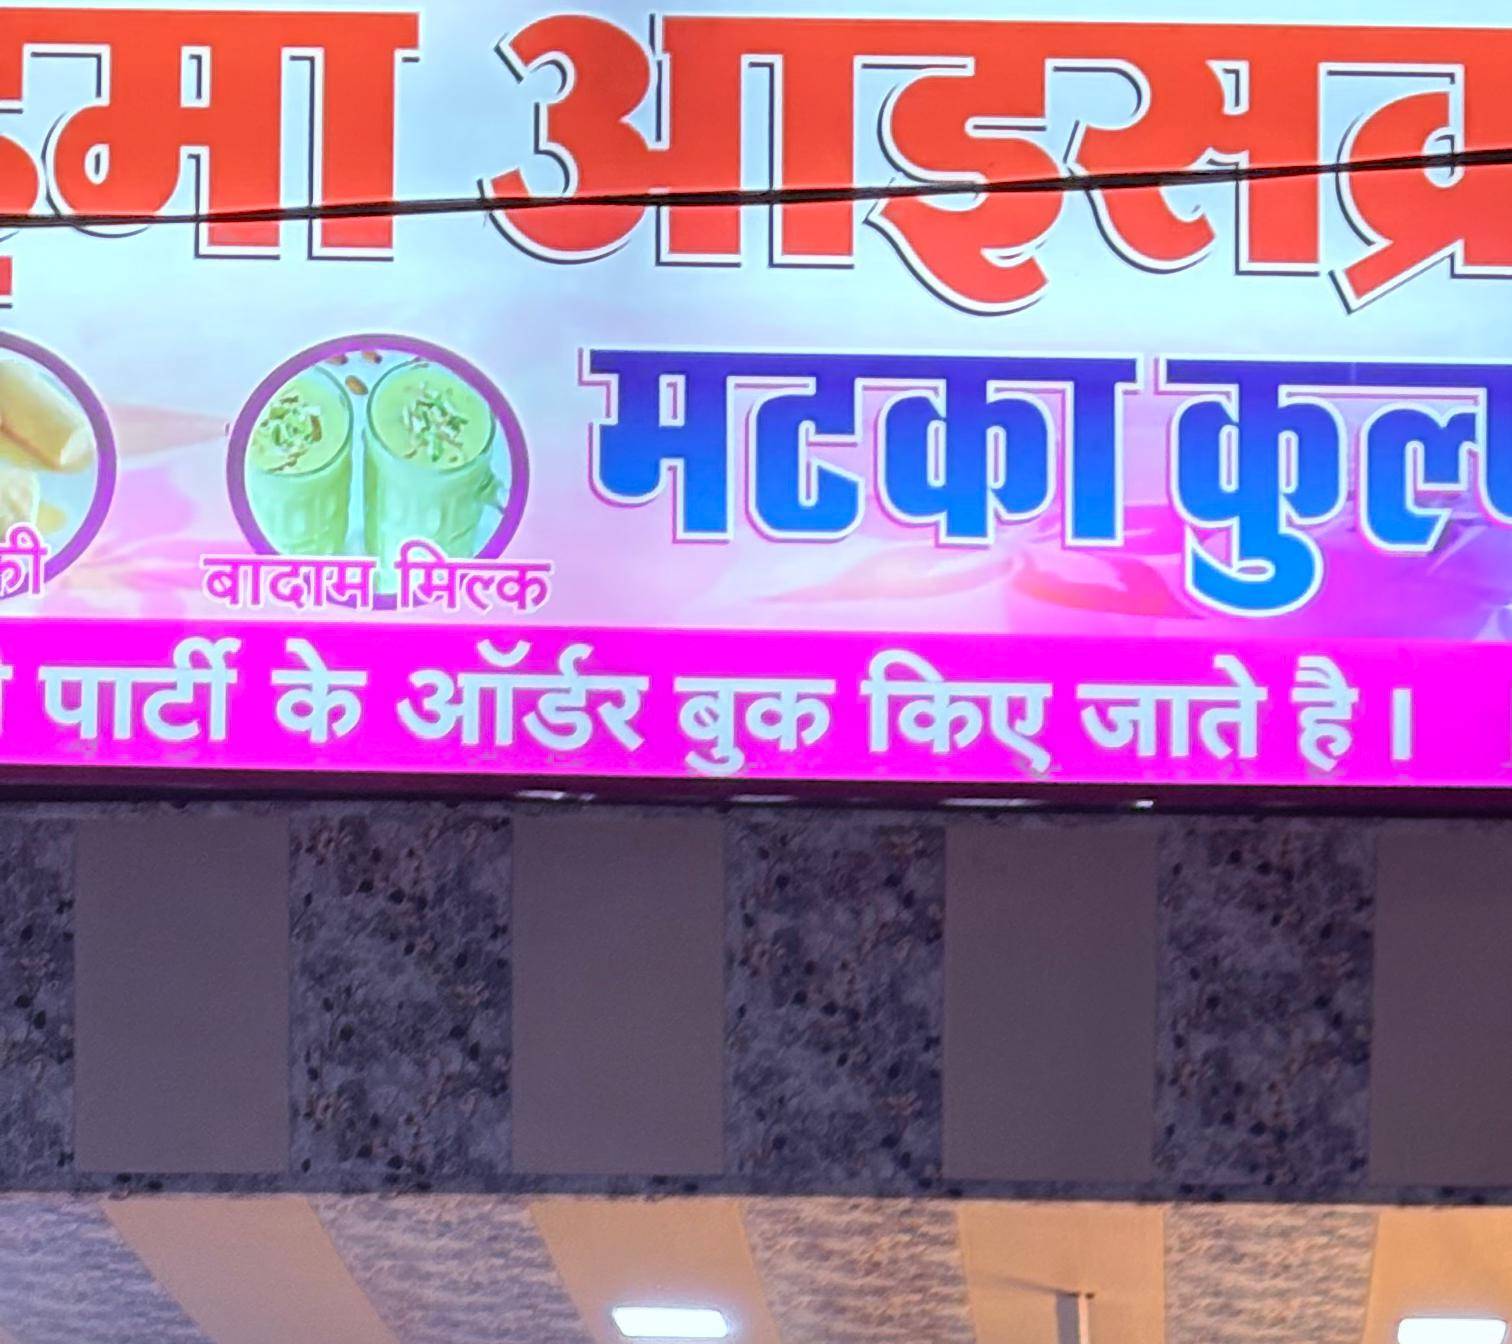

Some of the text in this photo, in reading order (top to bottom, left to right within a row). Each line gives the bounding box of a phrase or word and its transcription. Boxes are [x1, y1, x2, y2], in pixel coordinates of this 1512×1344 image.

[586, 350, 1138, 545] मटका
[203, 543, 551, 611] बादाम मिल्क
[39, 637, 241, 741] पार्टी
[272, 639, 367, 743] के
[398, 639, 648, 752] ऑर्डर
[675, 675, 836, 776] बुक
[861, 650, 1052, 774] किए
[1078, 655, 1267, 759] जाते
[1291, 656, 1358, 771] है
